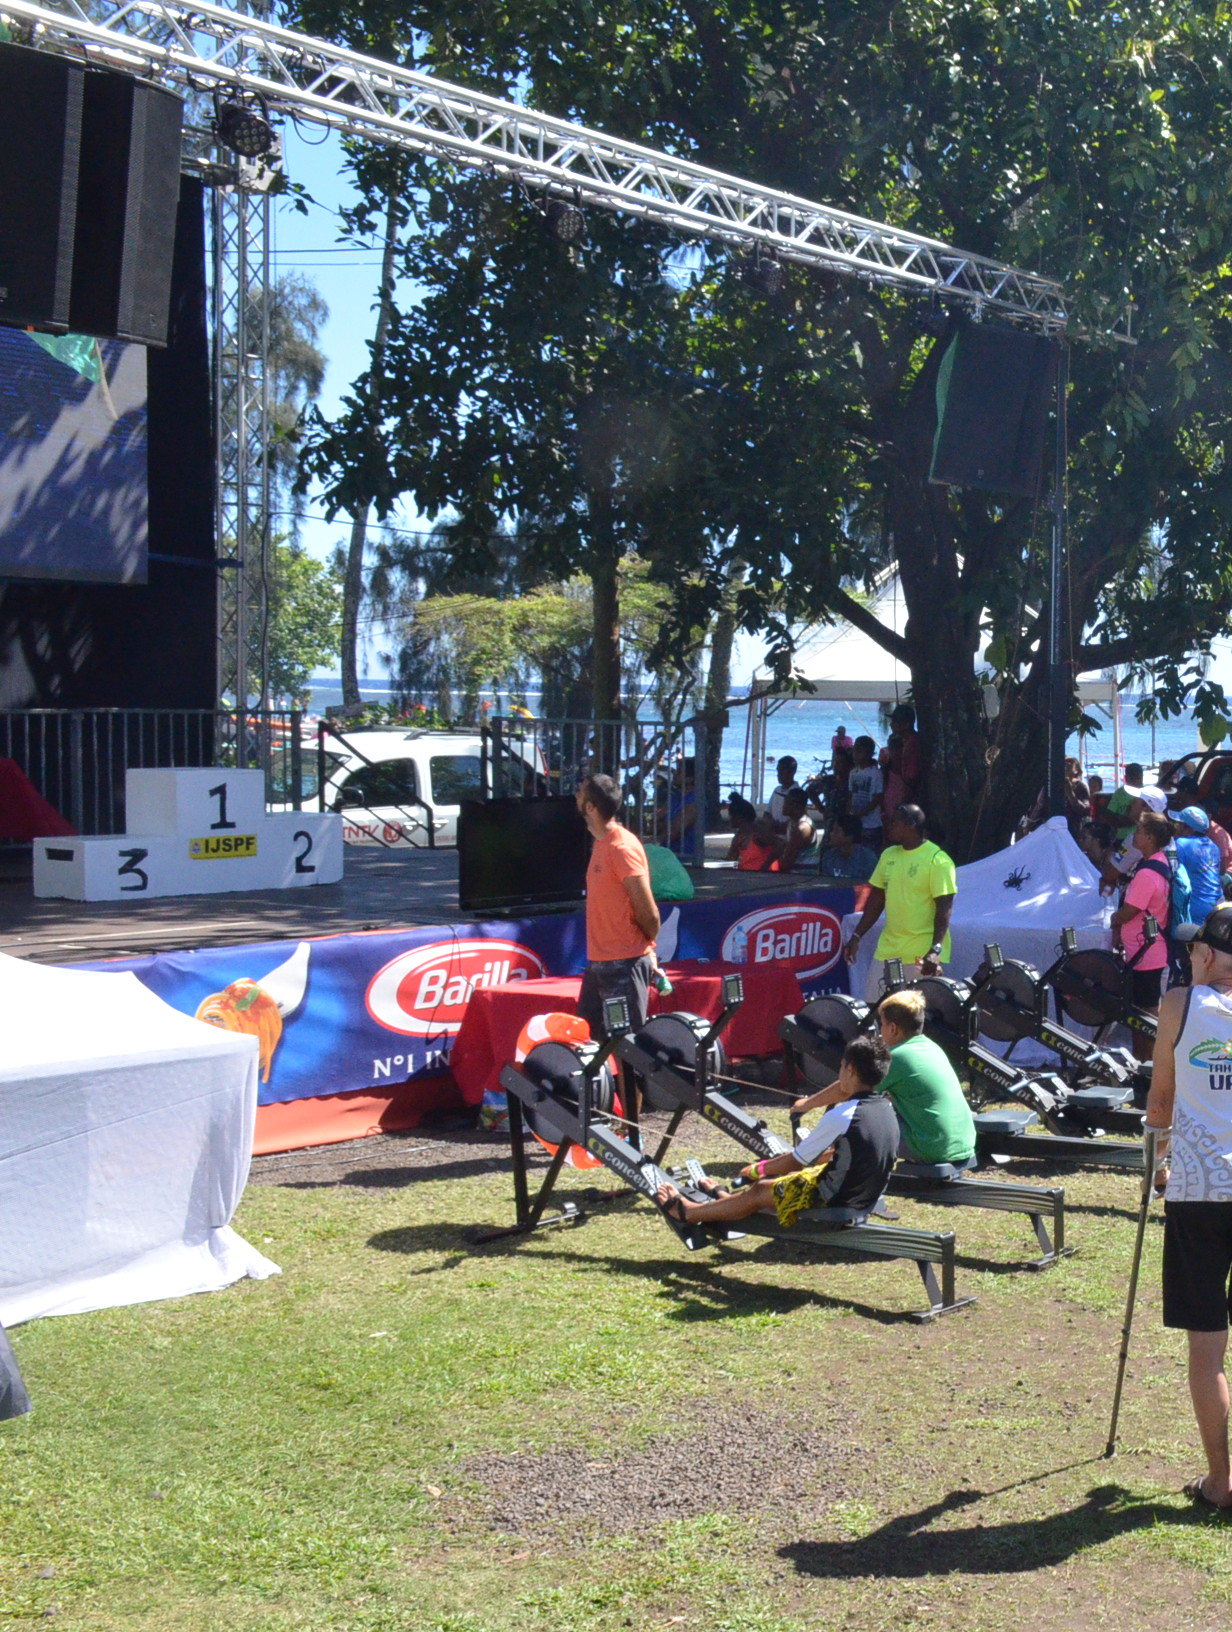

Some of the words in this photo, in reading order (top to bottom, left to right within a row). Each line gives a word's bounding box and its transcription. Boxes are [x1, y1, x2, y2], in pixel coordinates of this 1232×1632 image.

[208, 782, 236, 830] 1
[204, 837, 256, 854] IJSPF
[293, 830, 316, 874] 2
[118, 848, 149, 892] 3
[755, 921, 833, 963] Barilla
[1056, 1041, 1103, 1073] concpt
[983, 1067, 1031, 1100] concpt
[604, 1151, 652, 1191] concep
